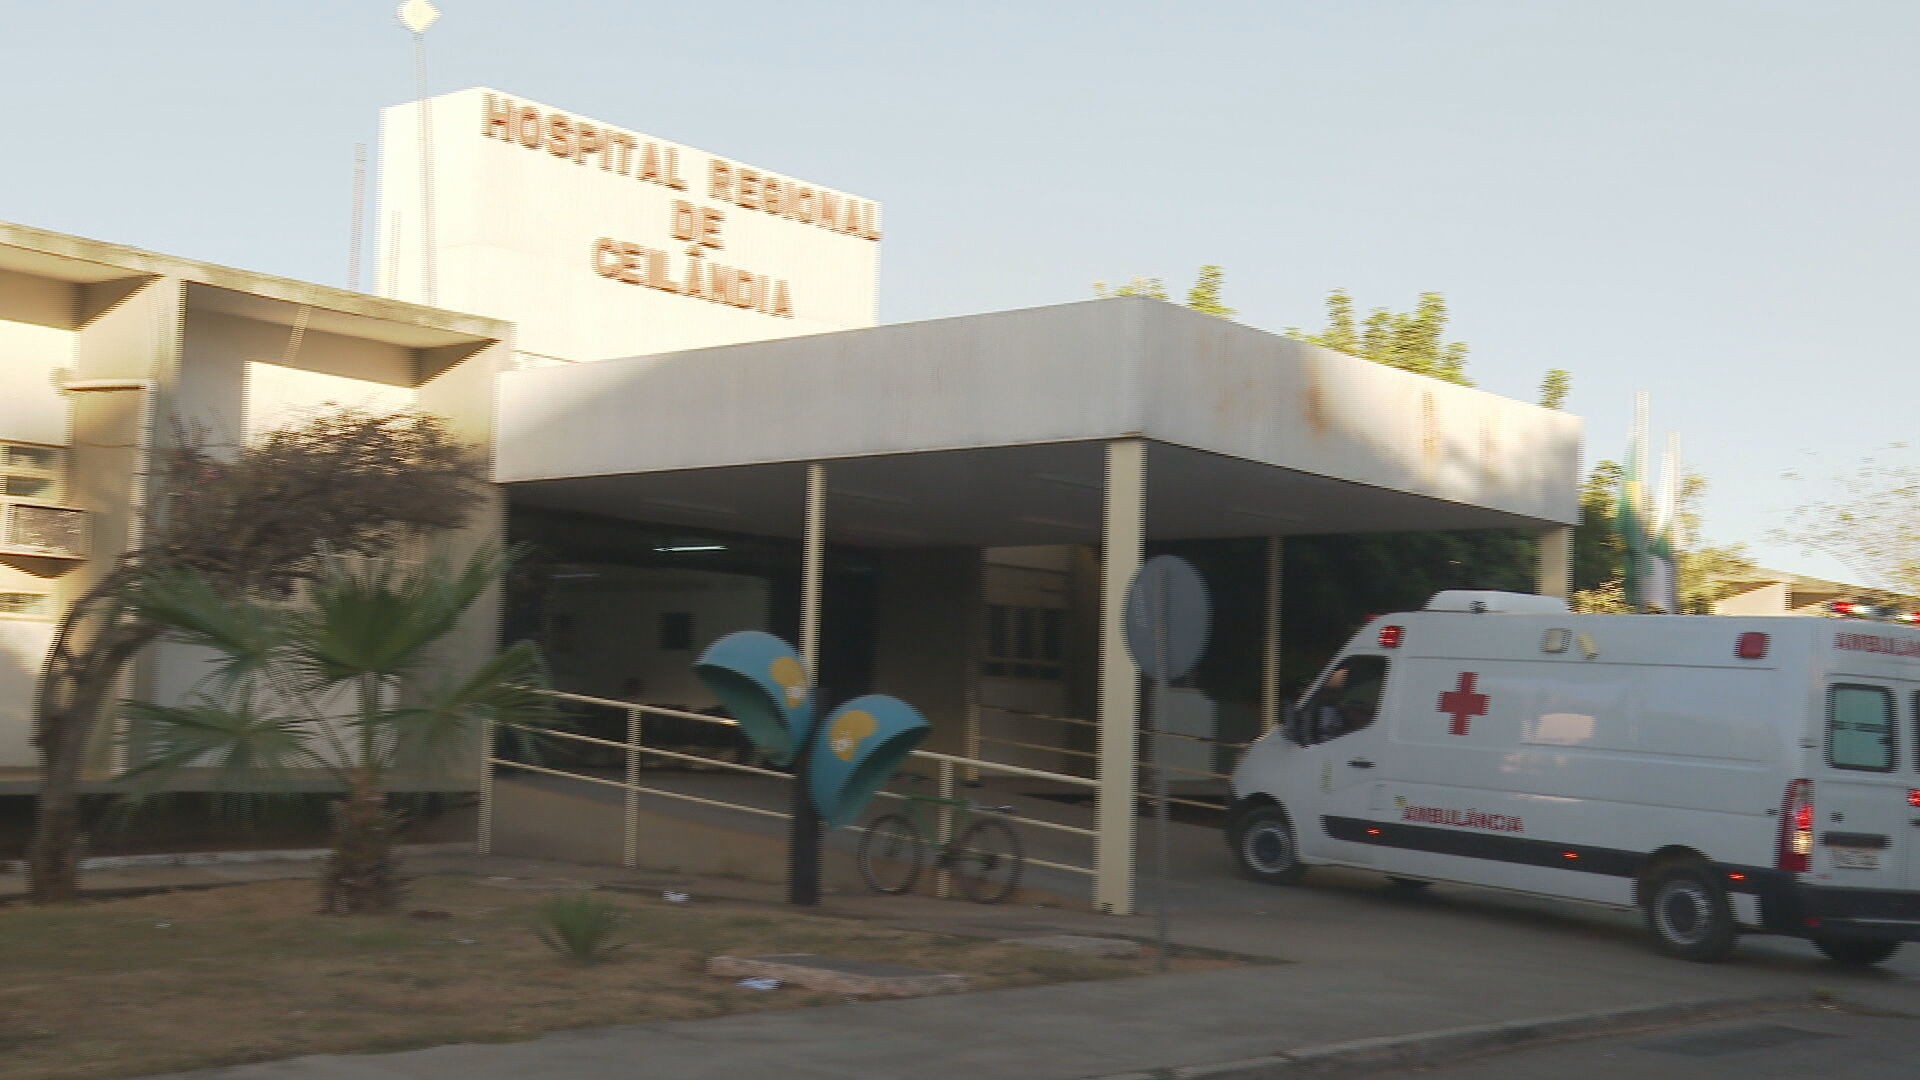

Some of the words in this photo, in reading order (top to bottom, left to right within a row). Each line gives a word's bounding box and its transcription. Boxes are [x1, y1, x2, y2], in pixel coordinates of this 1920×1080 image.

[481, 93, 688, 192] HOSPITAL
[708, 158, 882, 241] REGIONAL
[670, 199, 726, 250] DE
[590, 236, 796, 318] CEILÂNDIA
[1402, 805, 1525, 833] AMBULÂNCIA
